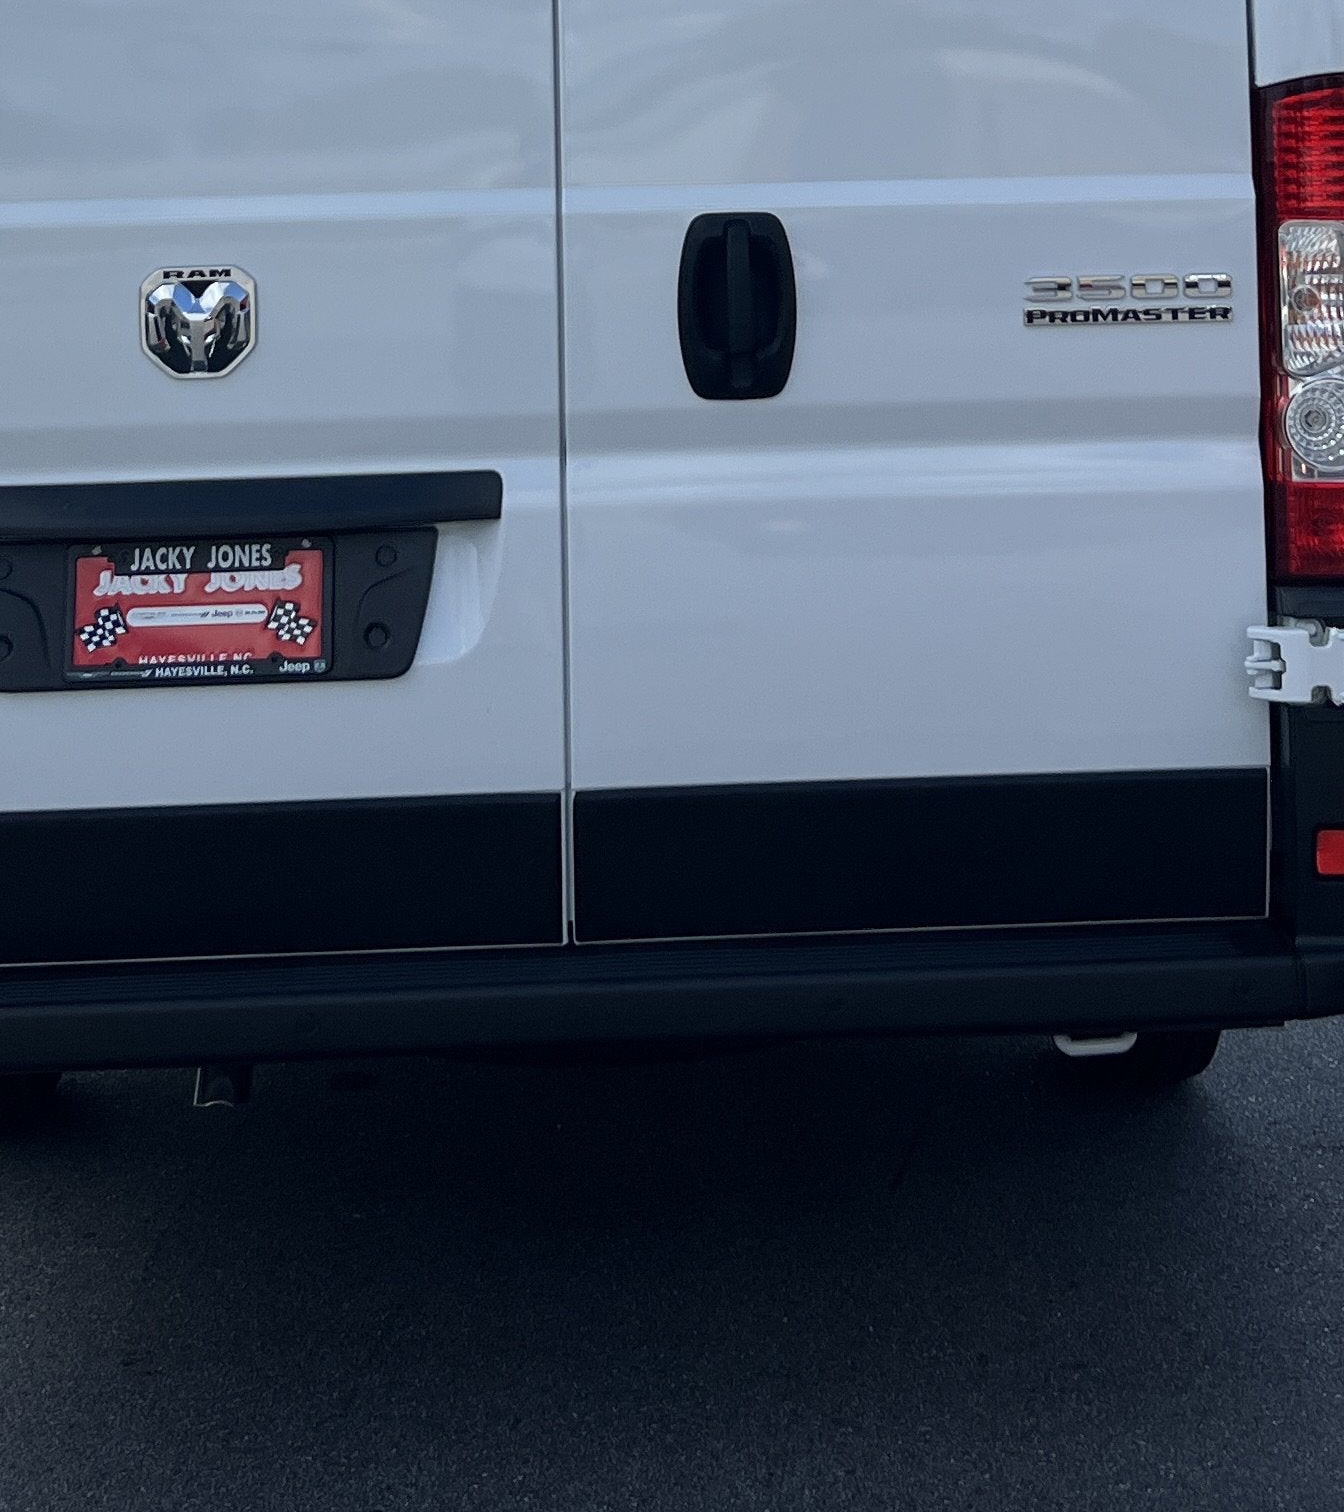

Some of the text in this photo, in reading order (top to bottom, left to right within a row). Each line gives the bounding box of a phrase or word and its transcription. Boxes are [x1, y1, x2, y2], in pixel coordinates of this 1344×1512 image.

[163, 268, 232, 279] RAM
[1023, 273, 1233, 302] 3500
[1024, 306, 1232, 325] PROMASTER
[130, 543, 272, 572] JACKY JONES
[93, 564, 303, 597] JACKY JONES
[155, 664, 228, 678] HAYESVILLE,
[230, 664, 254, 675] N.C.
[279, 660, 310, 674] Jeep
